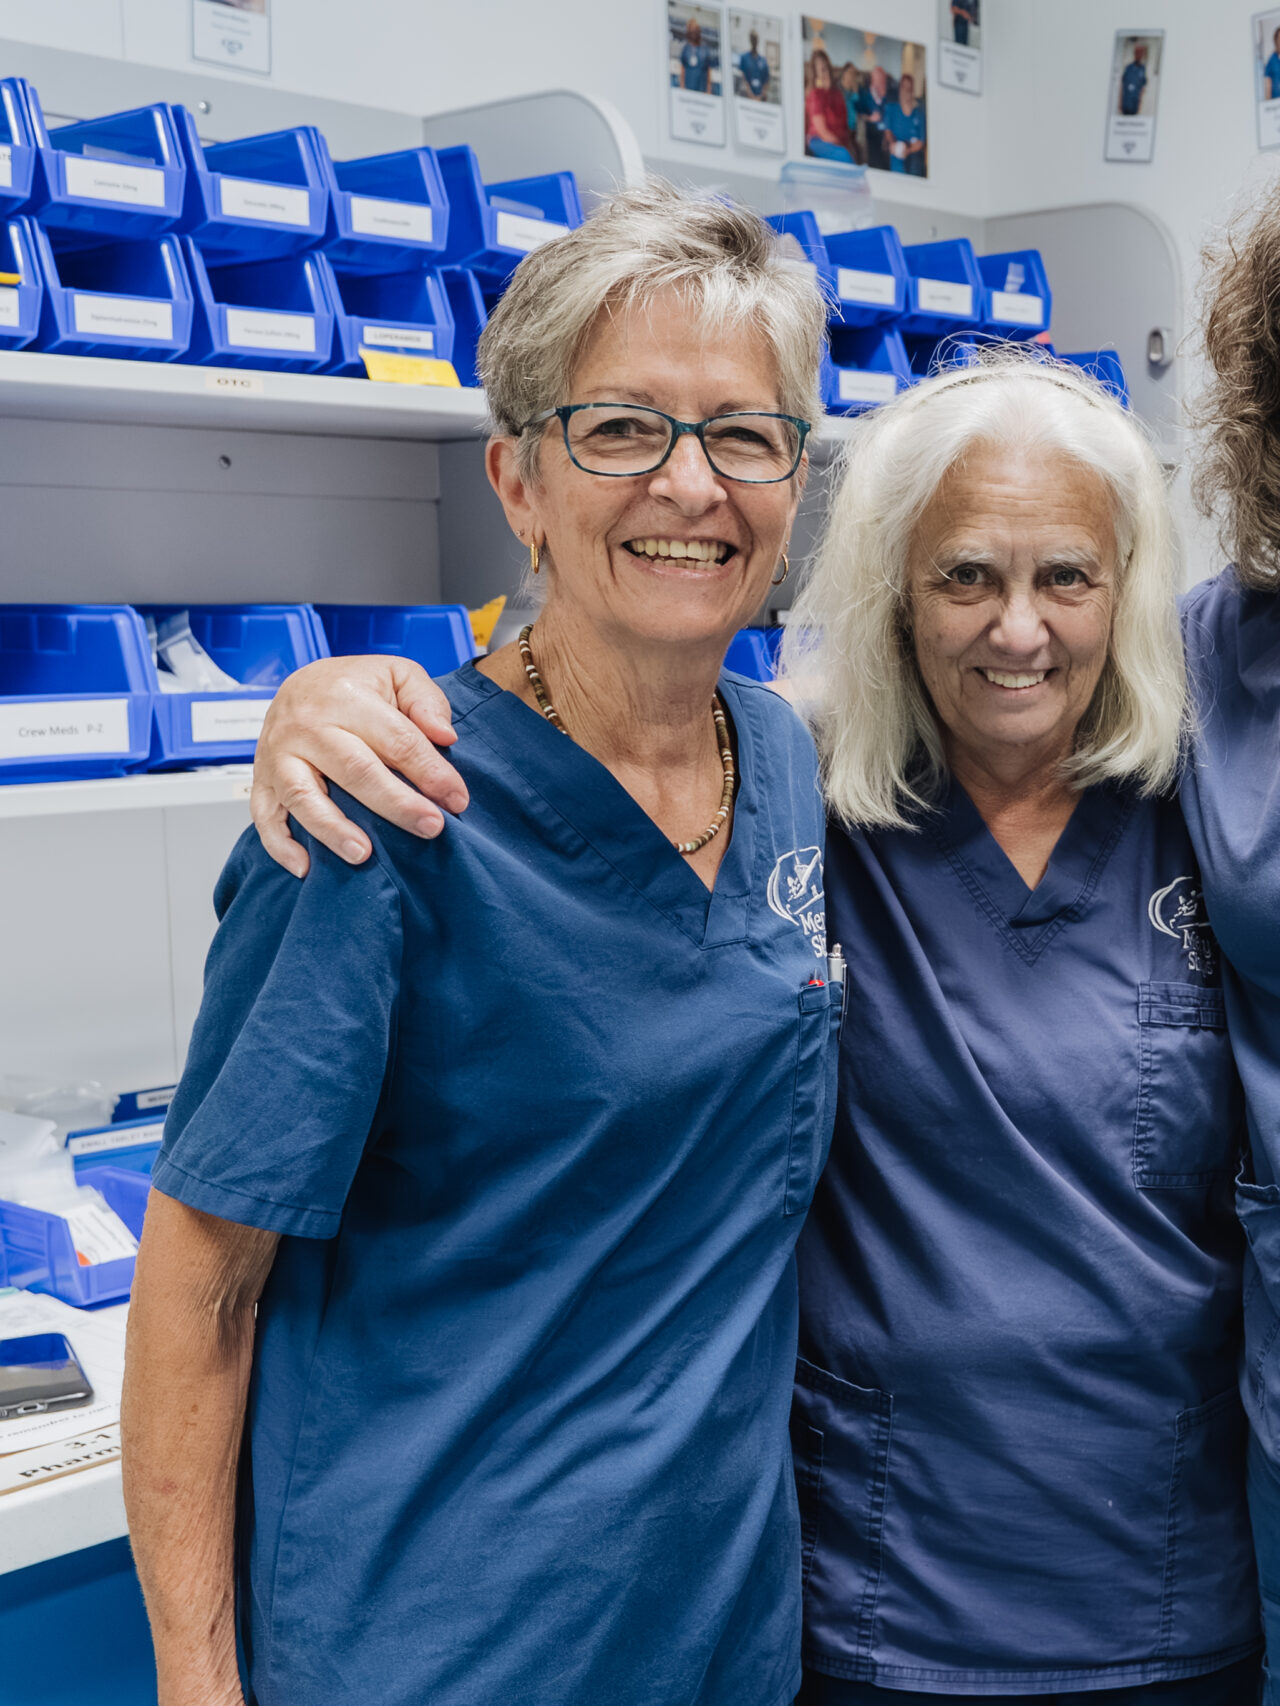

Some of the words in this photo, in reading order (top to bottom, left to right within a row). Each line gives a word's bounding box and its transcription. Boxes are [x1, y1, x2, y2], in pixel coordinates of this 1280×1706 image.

[216, 377, 252, 388] OTC
[18, 726, 47, 738] Crew
[49, 724, 79, 736] Meds
